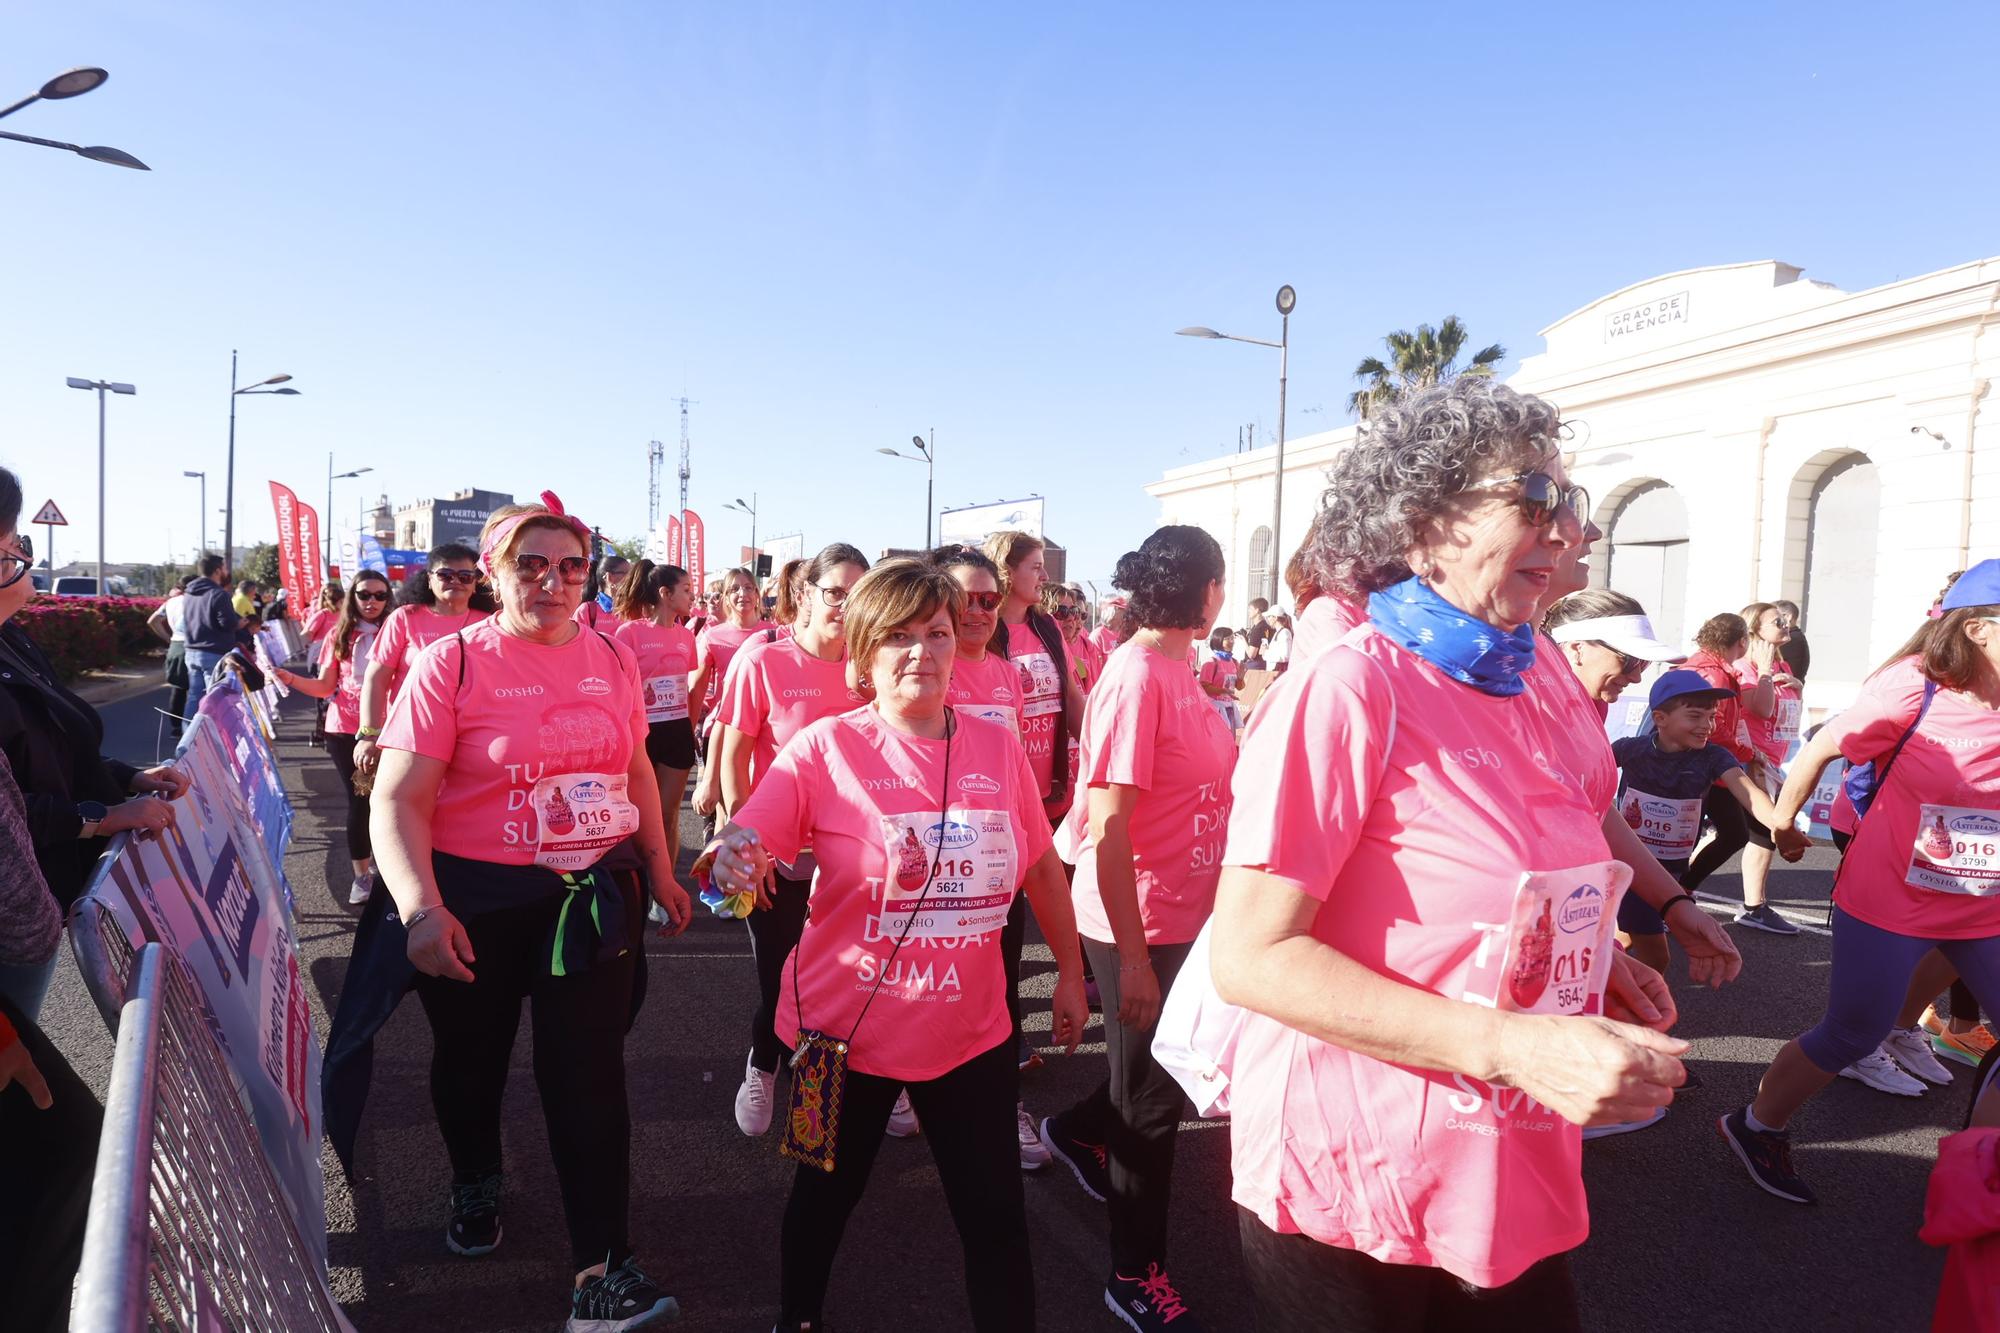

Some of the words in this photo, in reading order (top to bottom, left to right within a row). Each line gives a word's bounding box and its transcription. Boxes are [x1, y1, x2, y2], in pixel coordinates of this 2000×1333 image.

[1612, 306, 1651, 325] GRAO
[1659, 297, 1680, 312] DE
[1609, 310, 1682, 338] VALENCIA
[449, 509, 477, 518] PUERTO
[495, 685, 544, 697] OYSHO
[783, 688, 822, 698] OYSHO
[1925, 736, 1982, 749] OYSHO
[504, 762, 545, 784] TU
[577, 808, 611, 825] 016
[585, 826, 606, 837] 5637
[1643, 819, 1672, 832] 016
[1954, 821, 1998, 832] ASTURIANA
[928, 832, 974, 843] ASTURIANA
[552, 842, 584, 850] CARRERA
[1956, 841, 1996, 856] 016
[546, 855, 582, 865] OYSHO
[1961, 857, 1987, 867] 3799
[931, 859, 975, 878] 016
[1919, 872, 1959, 889] OYSHO
[936, 882, 964, 893] 5621
[900, 901, 934, 910] CARRERA
[948, 900, 959, 908] LA
[960, 899, 985, 908] MUJER
[988, 897, 1003, 905] 2023
[893, 917, 934, 929] OYSHO
[968, 912, 1005, 926] Santander
[1554, 947, 1592, 983] 016
[856, 955, 961, 992] SUMA
[855, 984, 889, 997] CARRERA
[889, 990, 901, 998] DE
